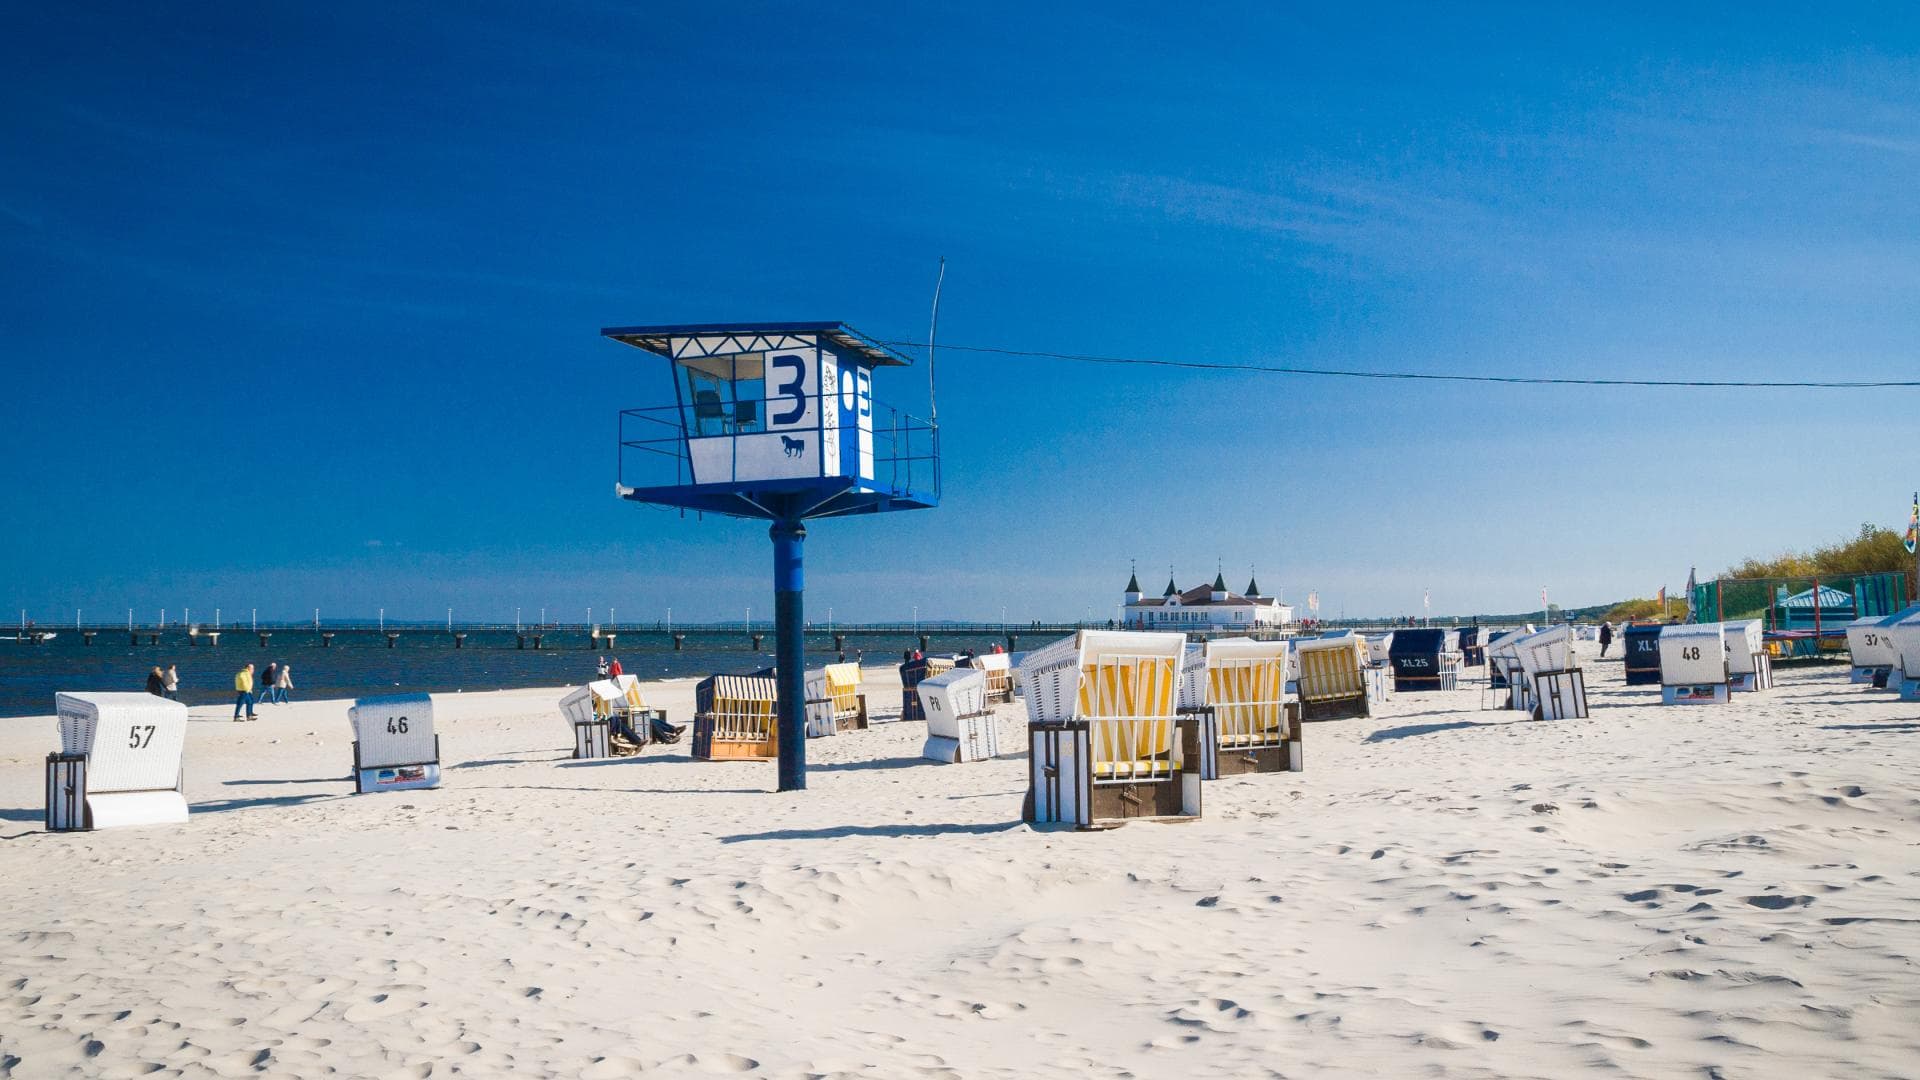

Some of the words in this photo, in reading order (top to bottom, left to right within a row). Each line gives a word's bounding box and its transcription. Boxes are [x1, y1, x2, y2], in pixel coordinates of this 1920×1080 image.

[773, 355, 806, 425] 3
[858, 372, 871, 417] 3
[1864, 634, 1878, 647] 37
[1401, 658, 1429, 668] XL25
[1682, 646, 1701, 661] 48
[387, 716, 409, 735] 46
[129, 725, 156, 749] 57
